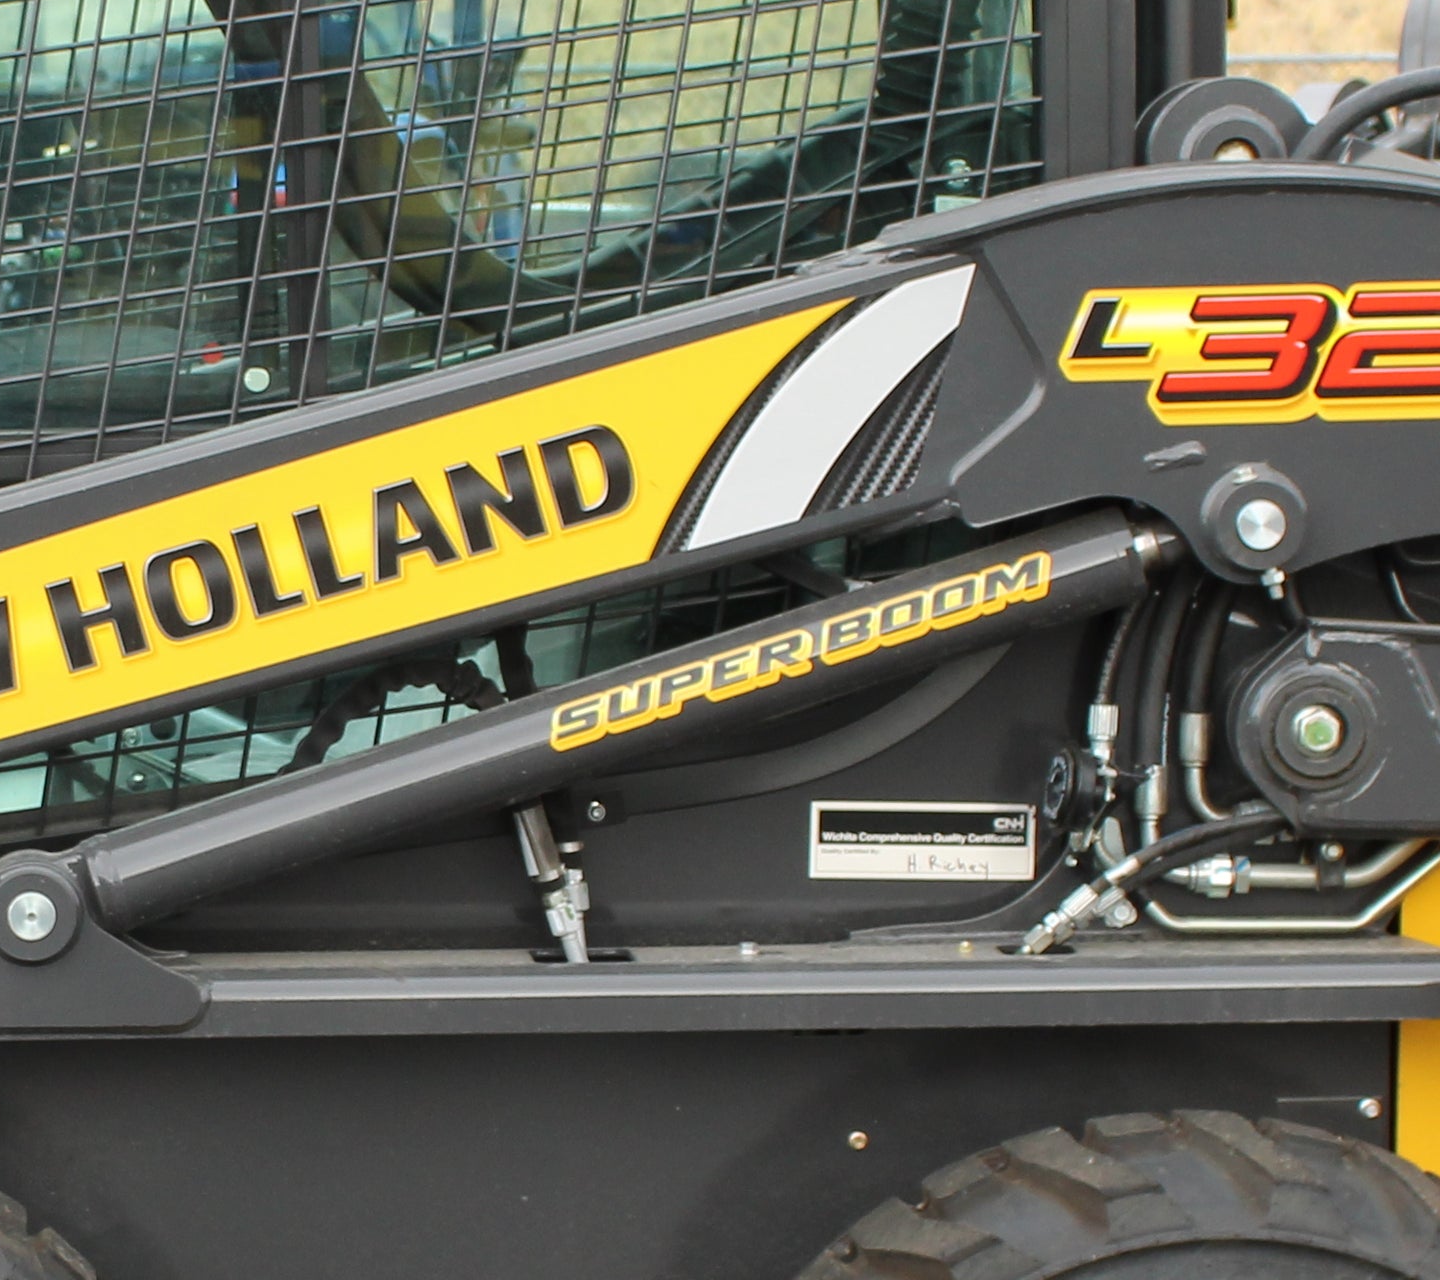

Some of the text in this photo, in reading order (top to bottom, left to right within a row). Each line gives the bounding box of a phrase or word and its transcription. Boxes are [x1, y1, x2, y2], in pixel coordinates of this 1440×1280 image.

[44, 423, 637, 673] HOLLAND
[554, 554, 1048, 744] SUPER BOOM
[822, 831, 1025, 844] Wichita Comprehensive Quality Certification
